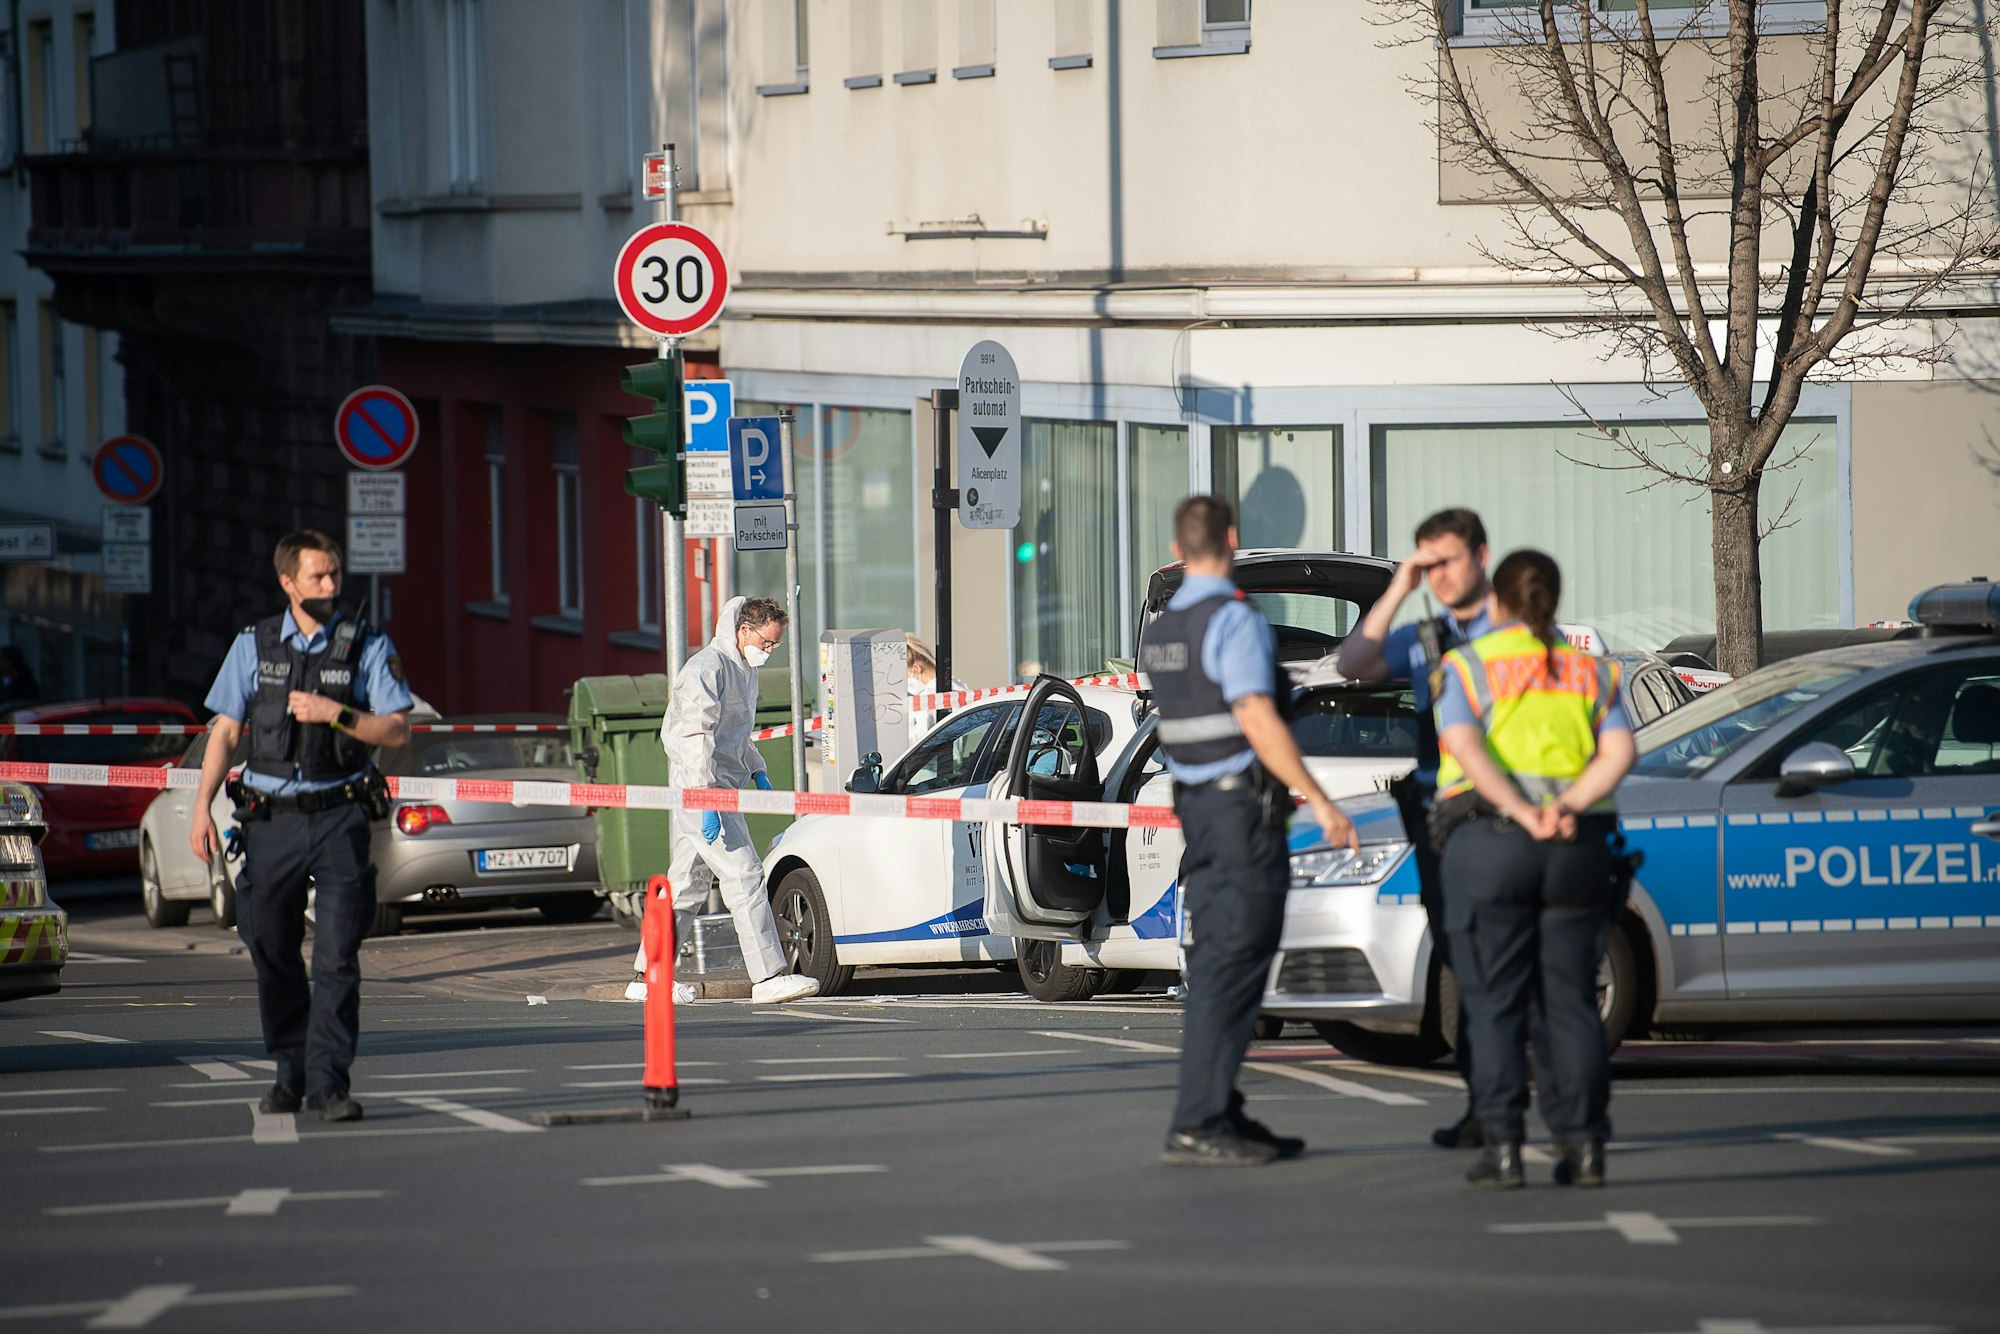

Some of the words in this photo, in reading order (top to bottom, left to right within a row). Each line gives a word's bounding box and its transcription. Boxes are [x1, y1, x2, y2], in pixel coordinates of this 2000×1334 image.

[642, 255, 703, 304] 30
[980, 354, 995, 365] 9914
[965, 376, 1015, 394] Parkschein-
[973, 400, 1007, 416] automat
[741, 428, 769, 490] P
[971, 467, 1008, 482] Alicenplatz
[754, 516, 768, 529] mit
[740, 529, 784, 542] Parkschein
[320, 670, 351, 686] VIDEO
[487, 852, 505, 867] MZ
[517, 851, 535, 865] XY
[538, 849, 564, 864] 707
